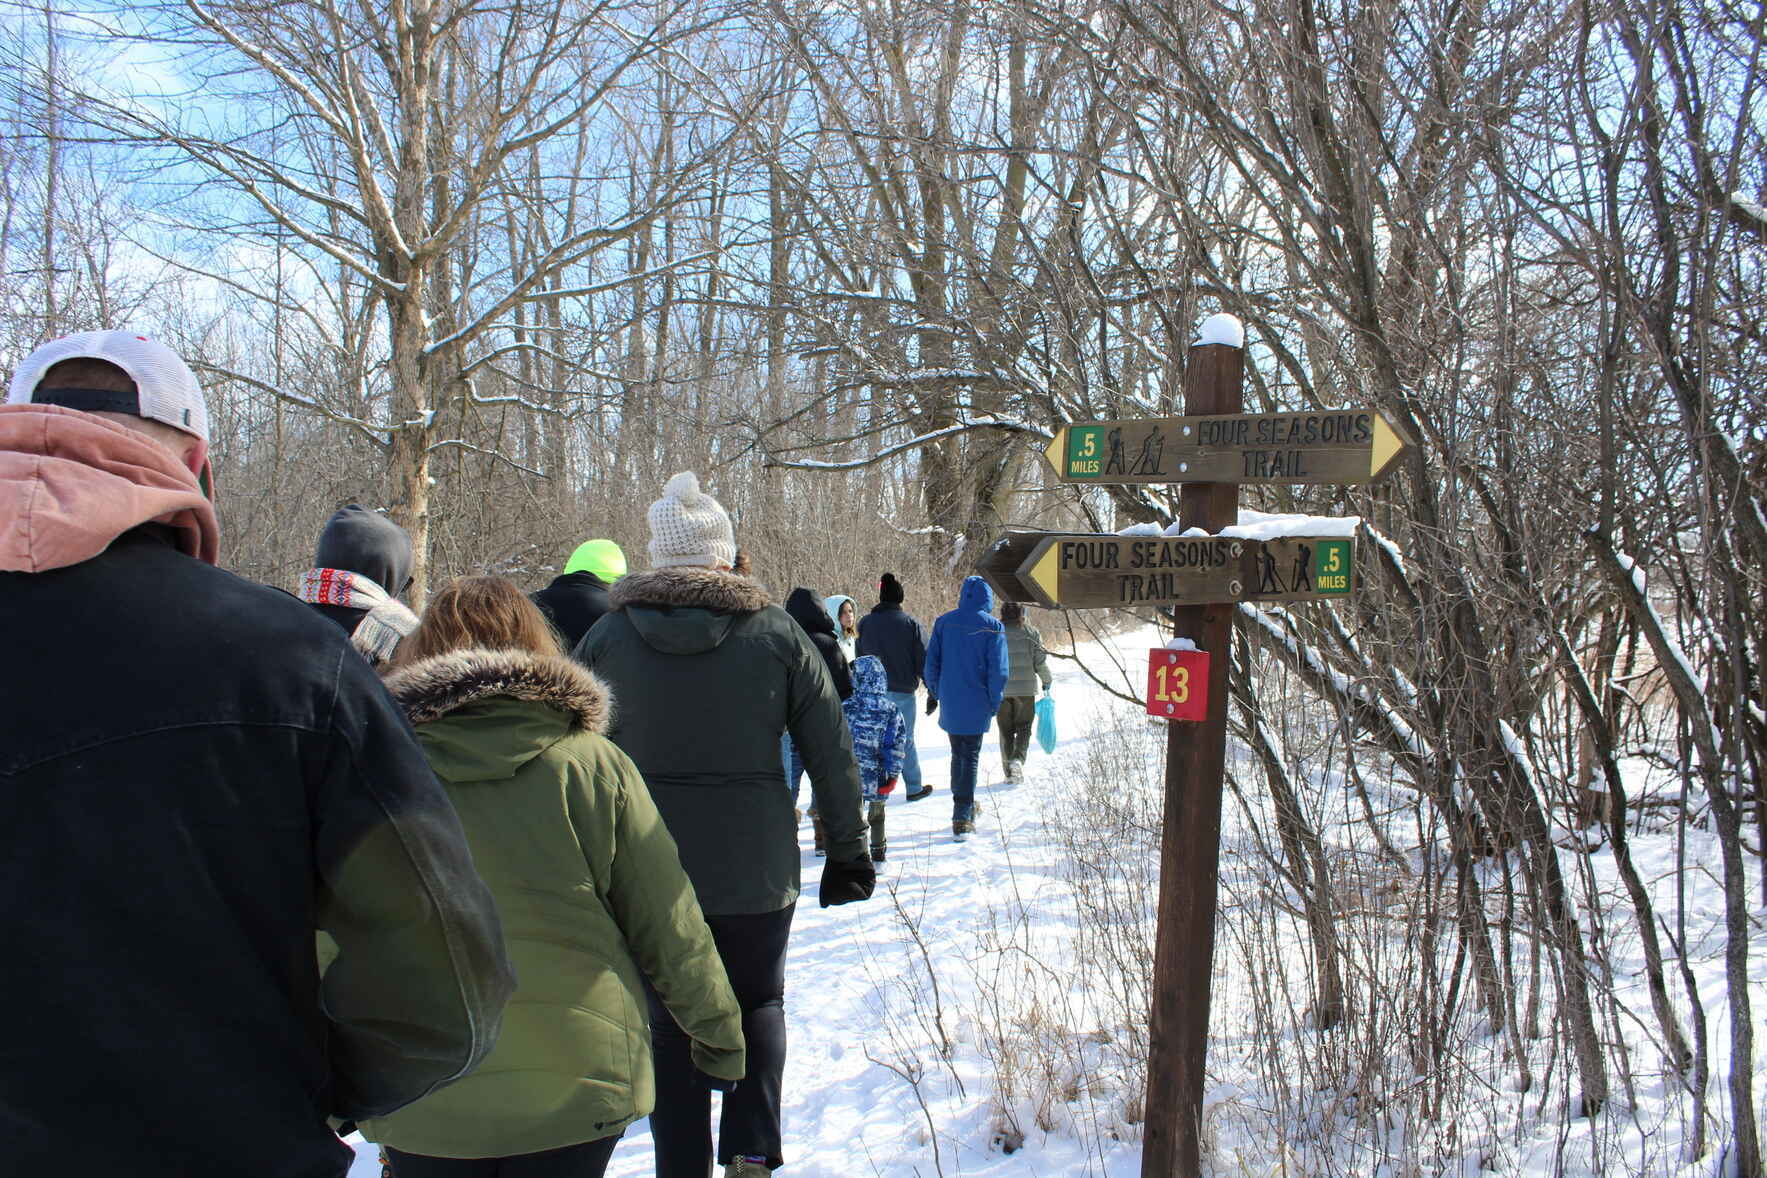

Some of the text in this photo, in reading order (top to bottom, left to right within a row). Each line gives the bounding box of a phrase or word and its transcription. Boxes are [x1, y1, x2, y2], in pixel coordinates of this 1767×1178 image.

[1197, 413, 1371, 446] FOUR SEASONS
[1078, 433, 1096, 457] .5
[1071, 460, 1100, 473] MILES
[1242, 450, 1308, 477] TRAIL
[1061, 541, 1227, 570] FOUR SEASONS
[1323, 547, 1341, 572] .5
[1117, 573, 1181, 602] TRAIL
[1318, 575, 1346, 589] MILES
[1155, 665, 1189, 703] 13
